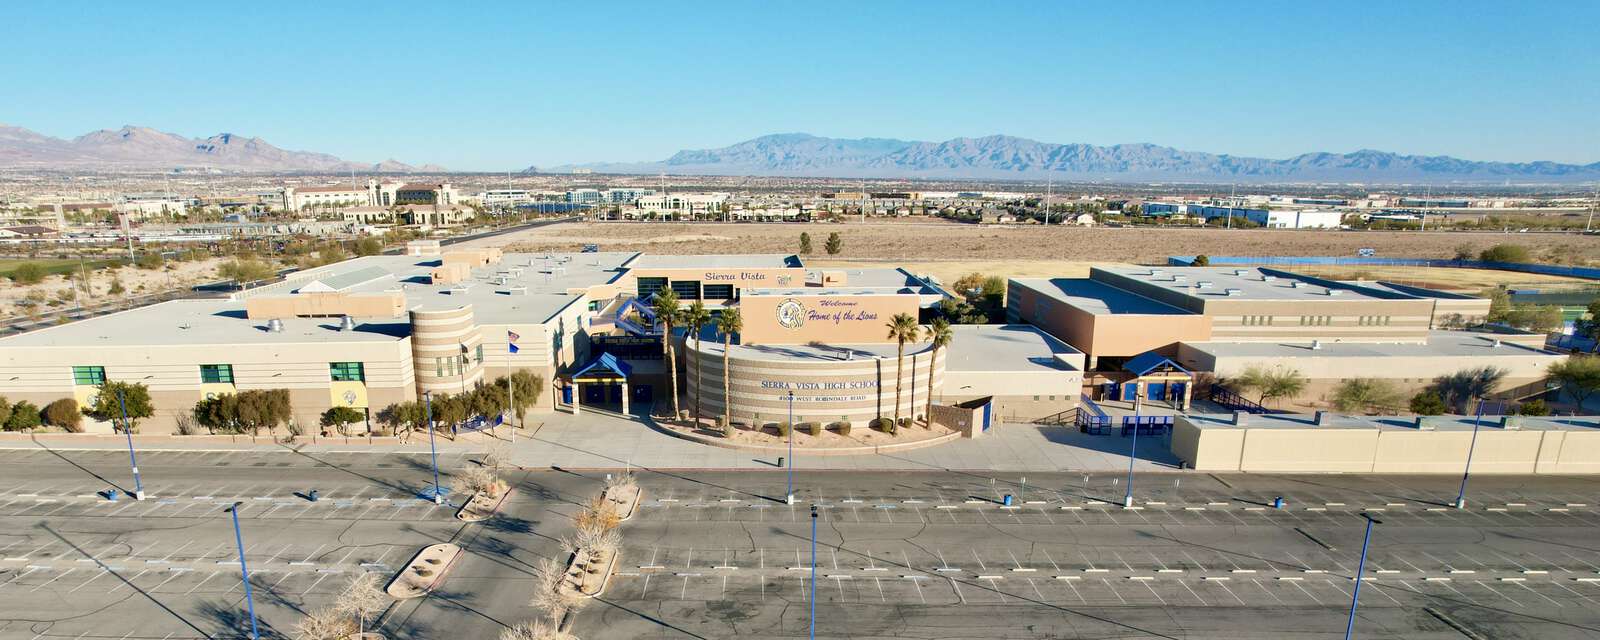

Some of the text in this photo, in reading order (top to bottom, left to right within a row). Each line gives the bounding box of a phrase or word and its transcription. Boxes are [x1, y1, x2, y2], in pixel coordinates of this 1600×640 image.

[705, 272, 766, 280] Sierra Vista
[808, 309, 878, 324] Home of the Lions
[761, 380, 880, 390] SIERRA VISTA HIGH SCHOO
